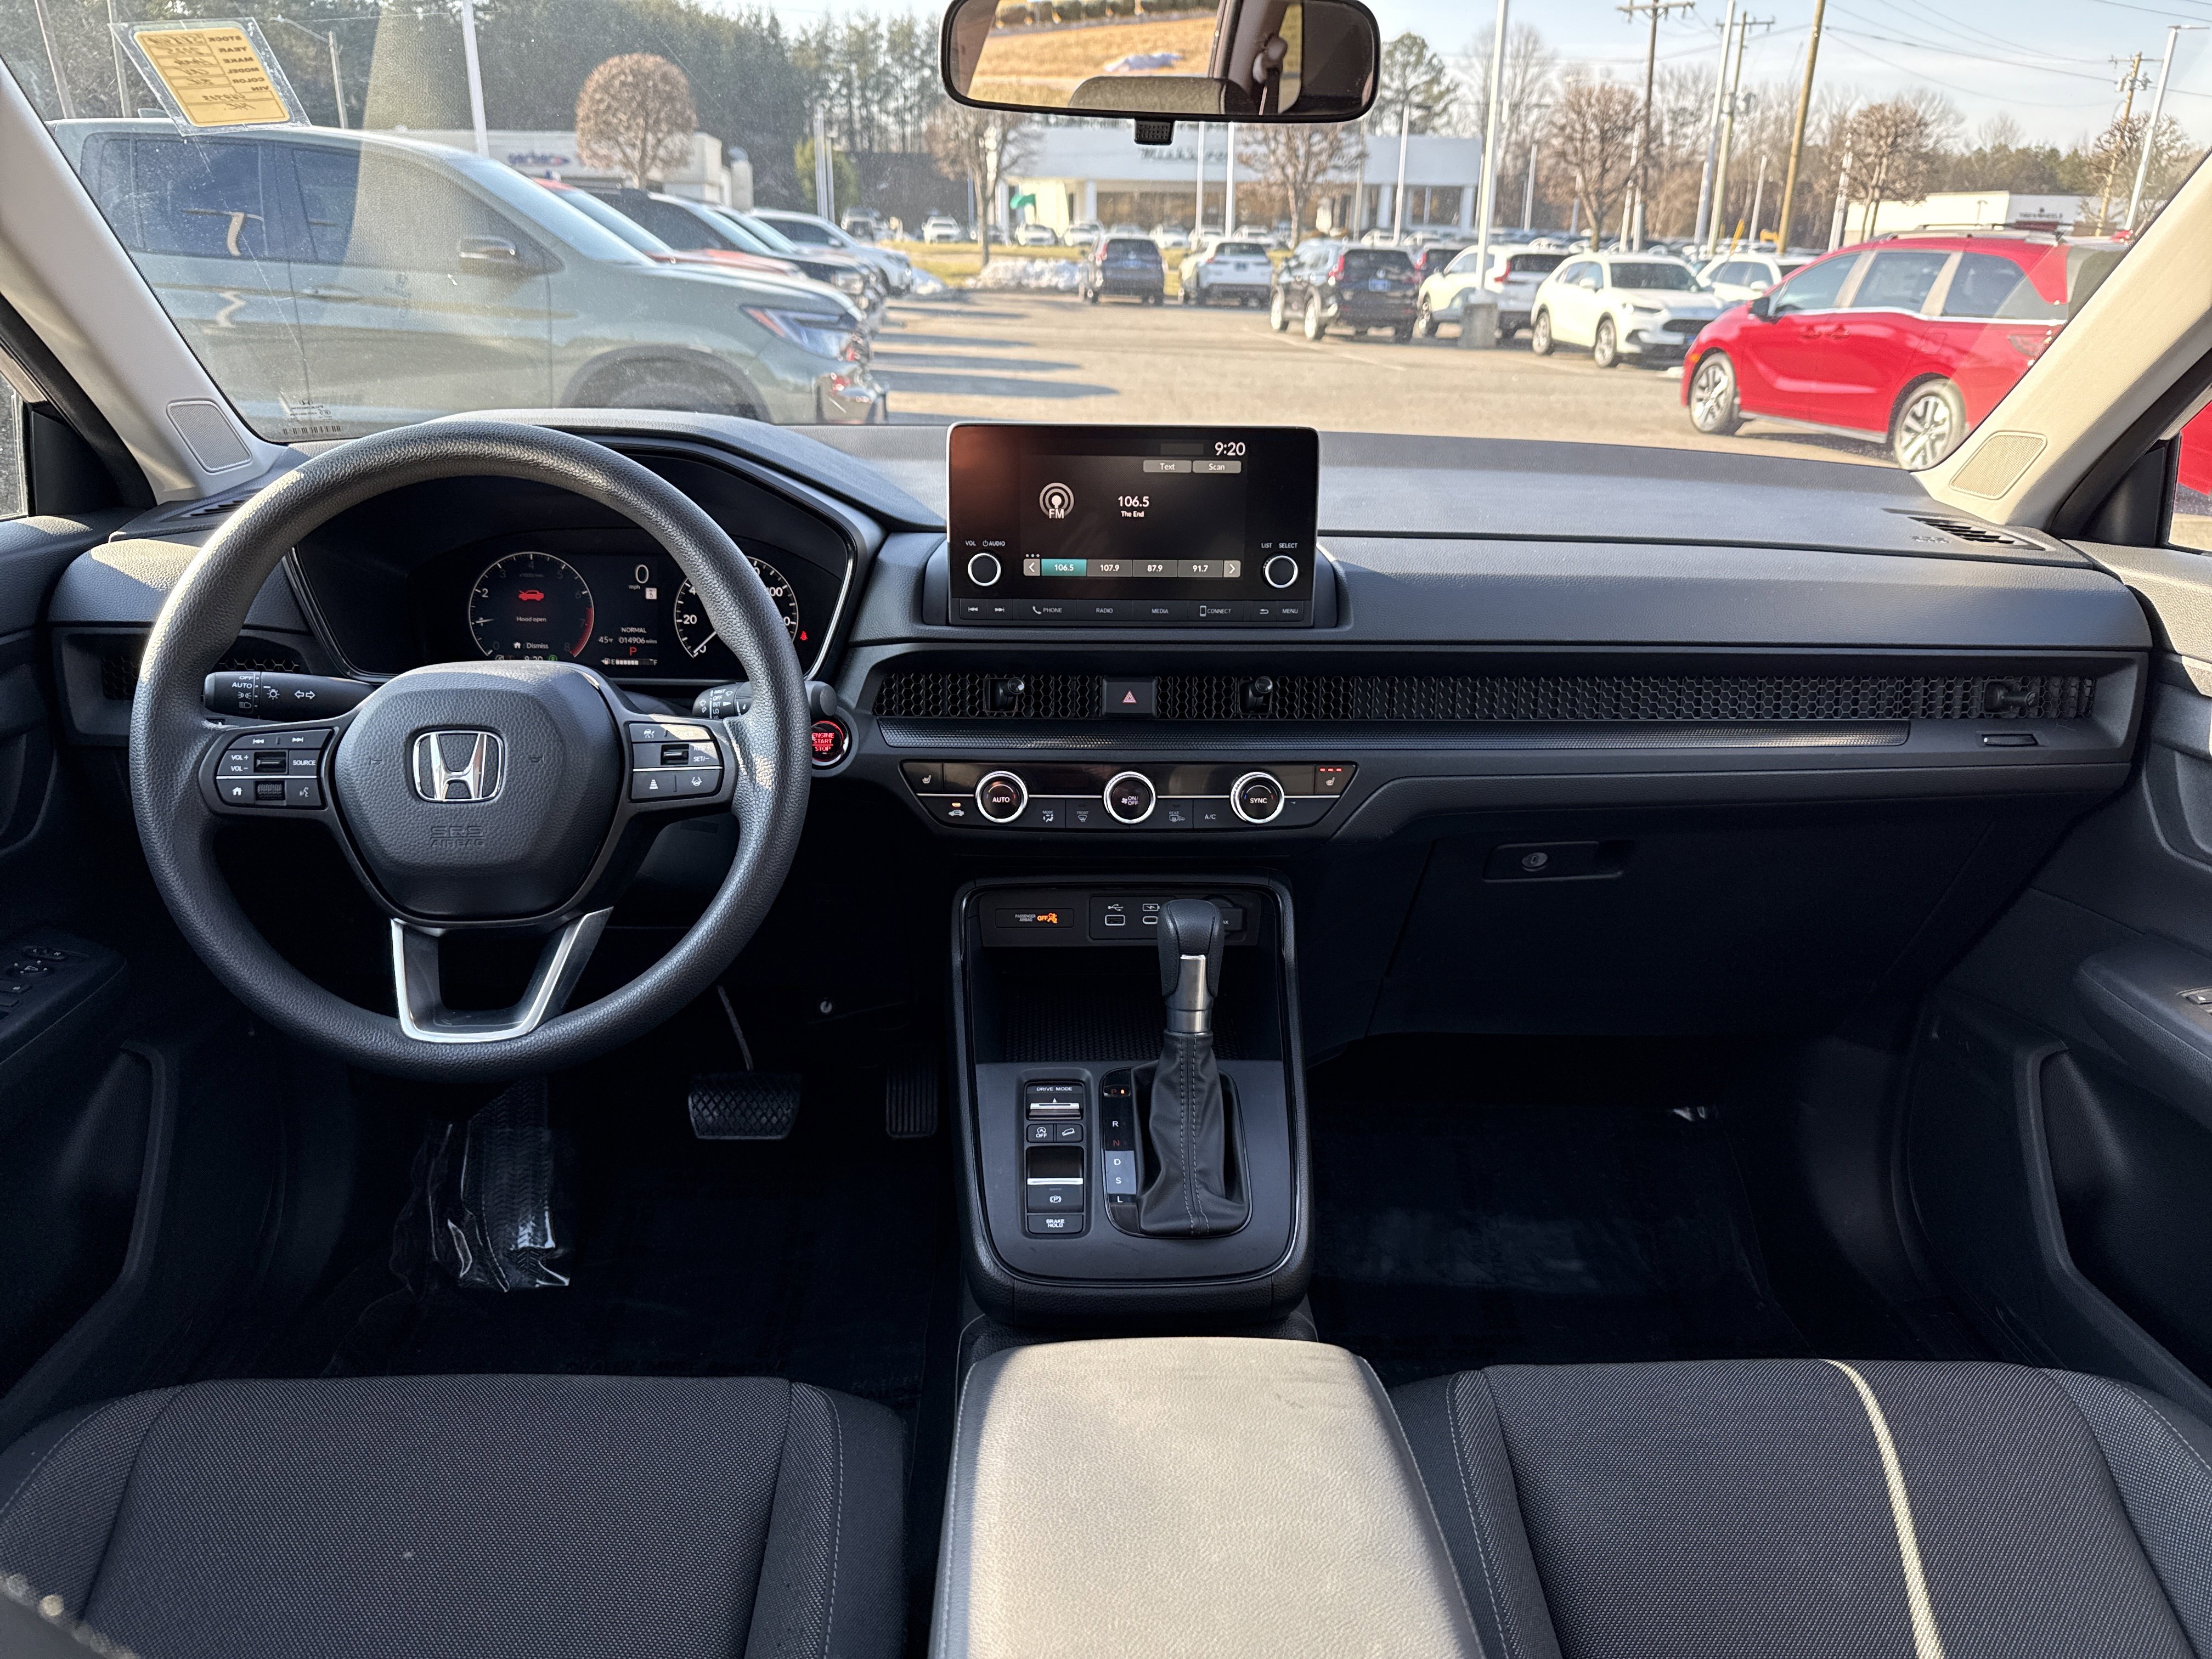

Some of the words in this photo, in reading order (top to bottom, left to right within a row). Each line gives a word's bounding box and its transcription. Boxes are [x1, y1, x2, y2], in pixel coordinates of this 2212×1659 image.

[1214, 442, 1245, 457] 9:20
[1118, 496, 1149, 507] 106.5
[1048, 509, 1064, 519] FM
[528, 561, 534, 569] 4
[500, 570, 506, 578] 3
[557, 571, 563, 579] 5
[635, 564, 649, 584] 0
[482, 588, 488, 597] 2
[768, 586, 783, 597] 00
[683, 614, 697, 624] 20
[629, 646, 637, 656] P
[292, 758, 316, 766] SOURCE
[431, 826, 484, 836] SRS
[431, 839, 484, 847] AIRBAG
